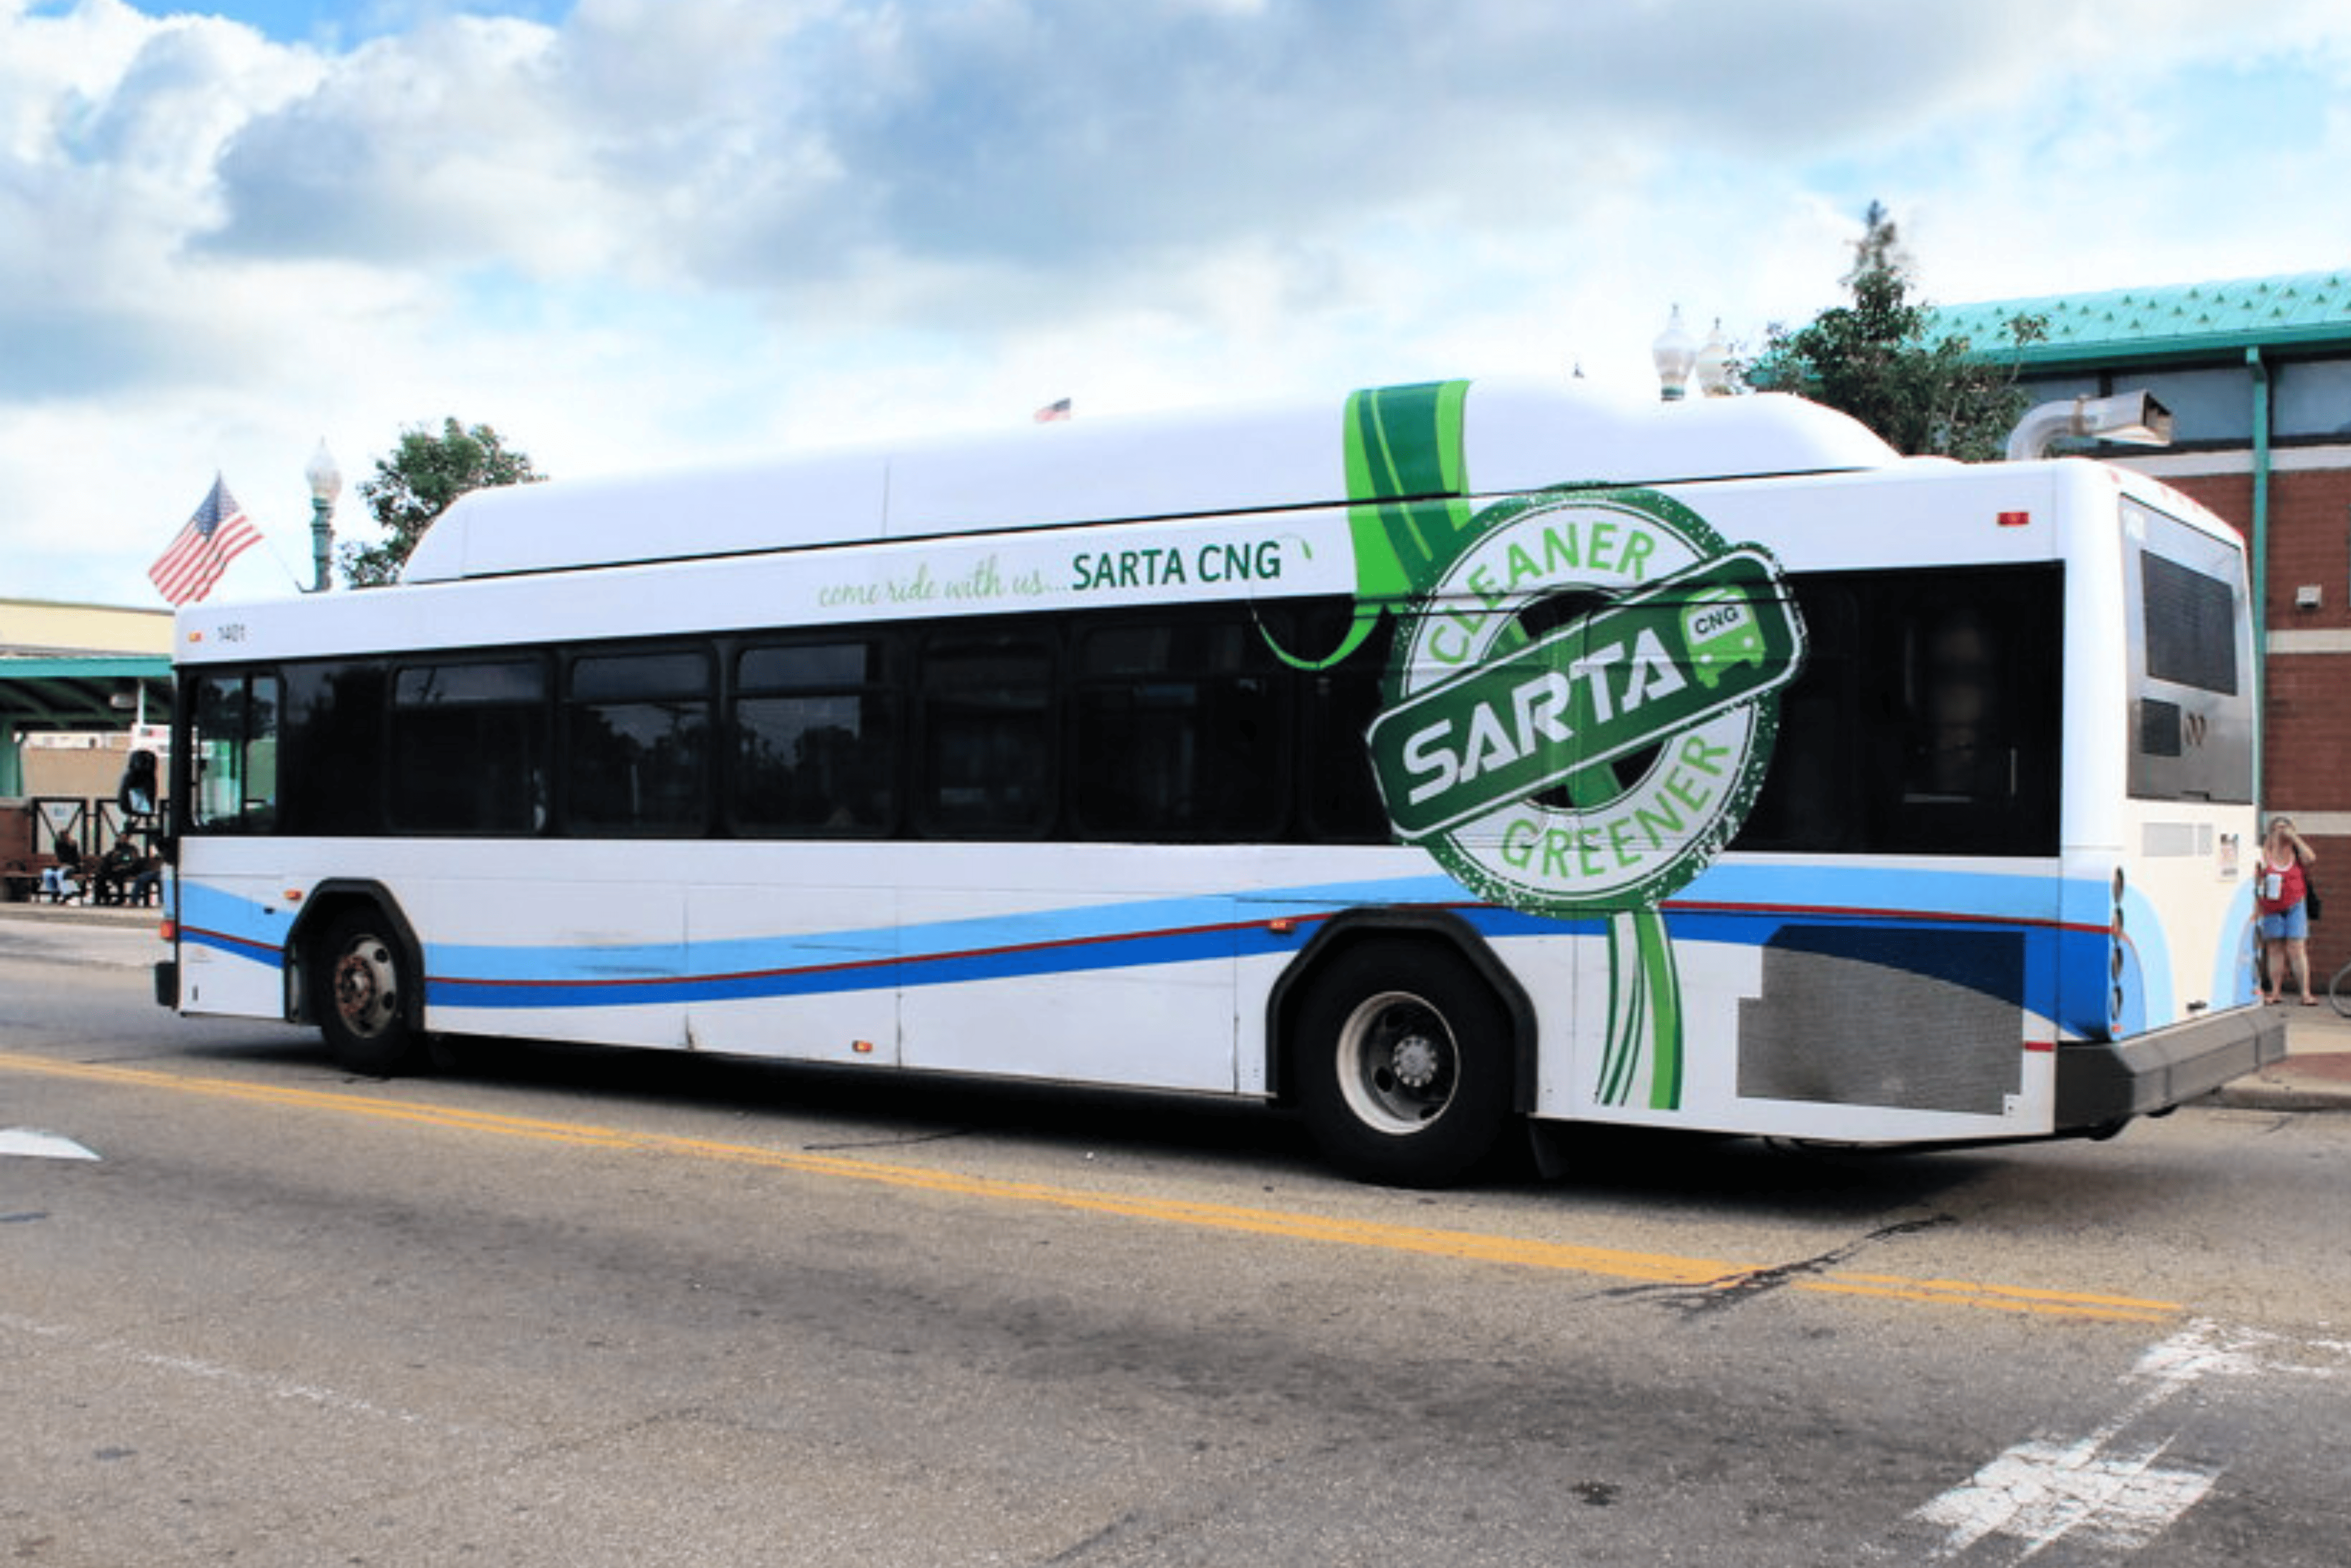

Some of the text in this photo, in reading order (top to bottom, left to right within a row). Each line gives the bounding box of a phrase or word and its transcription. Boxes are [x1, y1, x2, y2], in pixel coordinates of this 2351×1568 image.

[819, 581, 877, 607] come
[886, 561, 935, 602] ride
[943, 553, 1002, 597] with
[1072, 547, 1186, 591] SARTA
[1197, 540, 1281, 583] CNG
[1428, 522, 1655, 665] CLEANER
[1695, 606, 1739, 636] CNG
[1403, 627, 1688, 805] SARTA
[1500, 735, 1731, 879] GREENER
